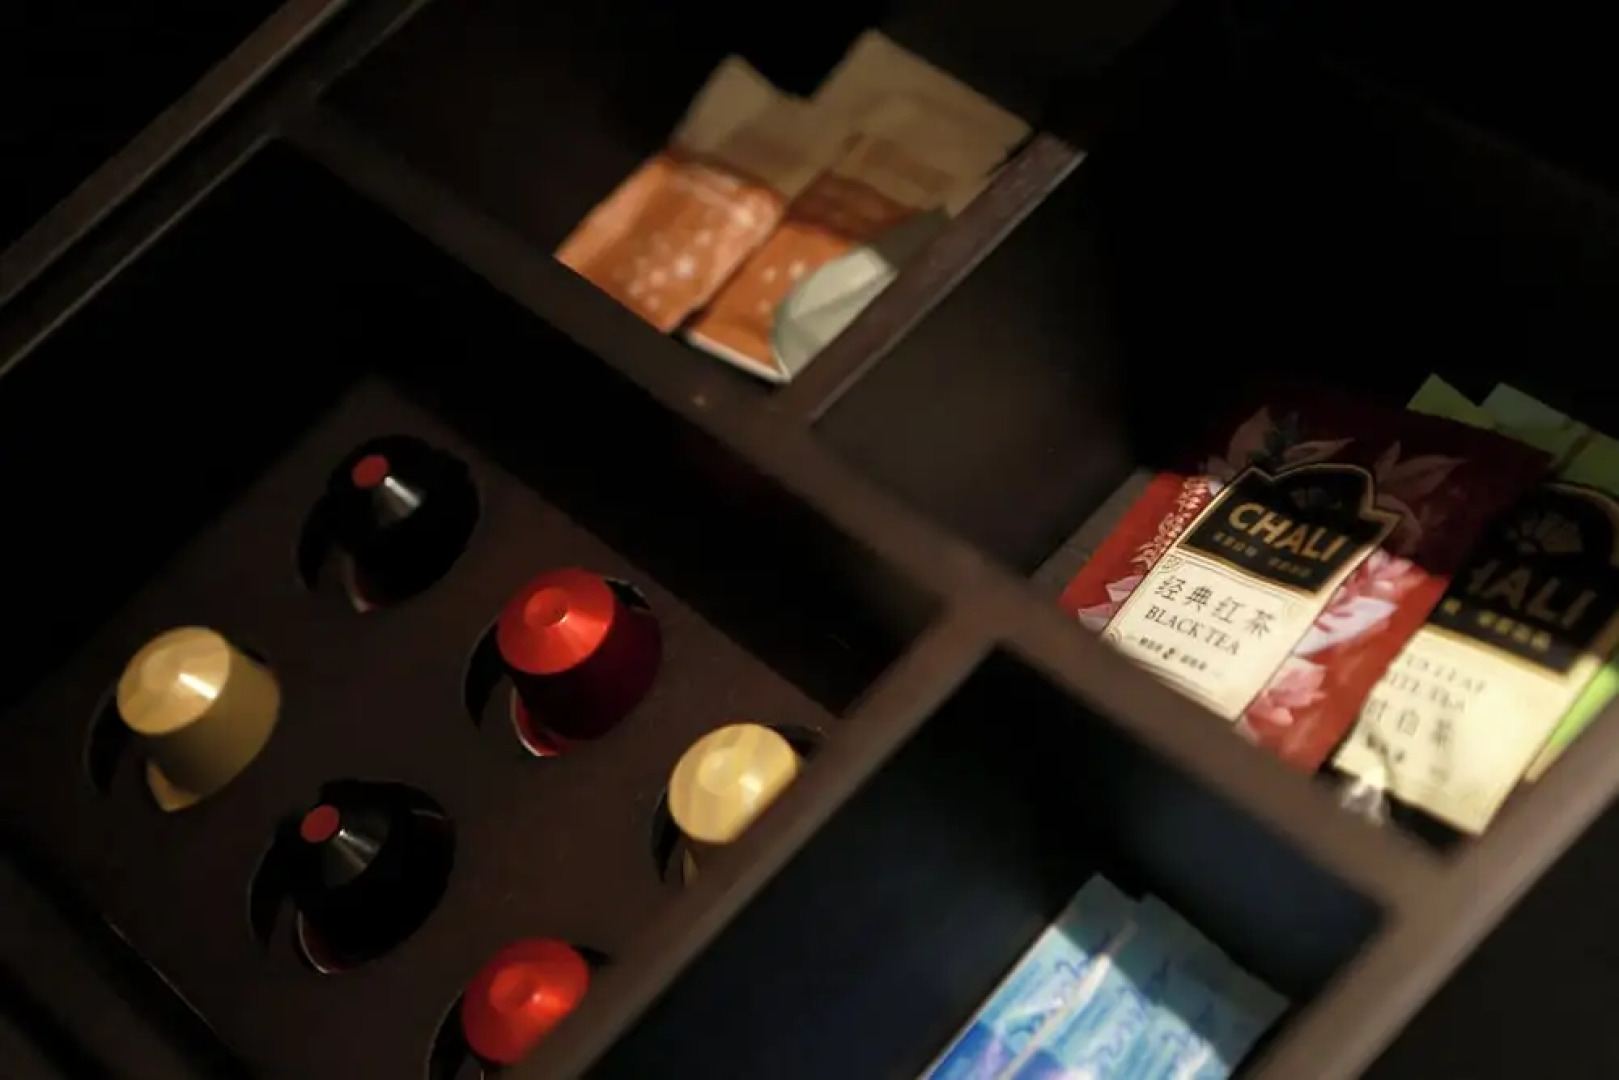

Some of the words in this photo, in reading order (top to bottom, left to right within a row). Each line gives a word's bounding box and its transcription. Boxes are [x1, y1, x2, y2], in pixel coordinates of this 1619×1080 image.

[1229, 502, 1349, 563] CHALI
[1145, 605, 1204, 639] BLACK
[1205, 625, 1241, 655] TEA
[1154, 575, 1276, 639] 经典红茶
